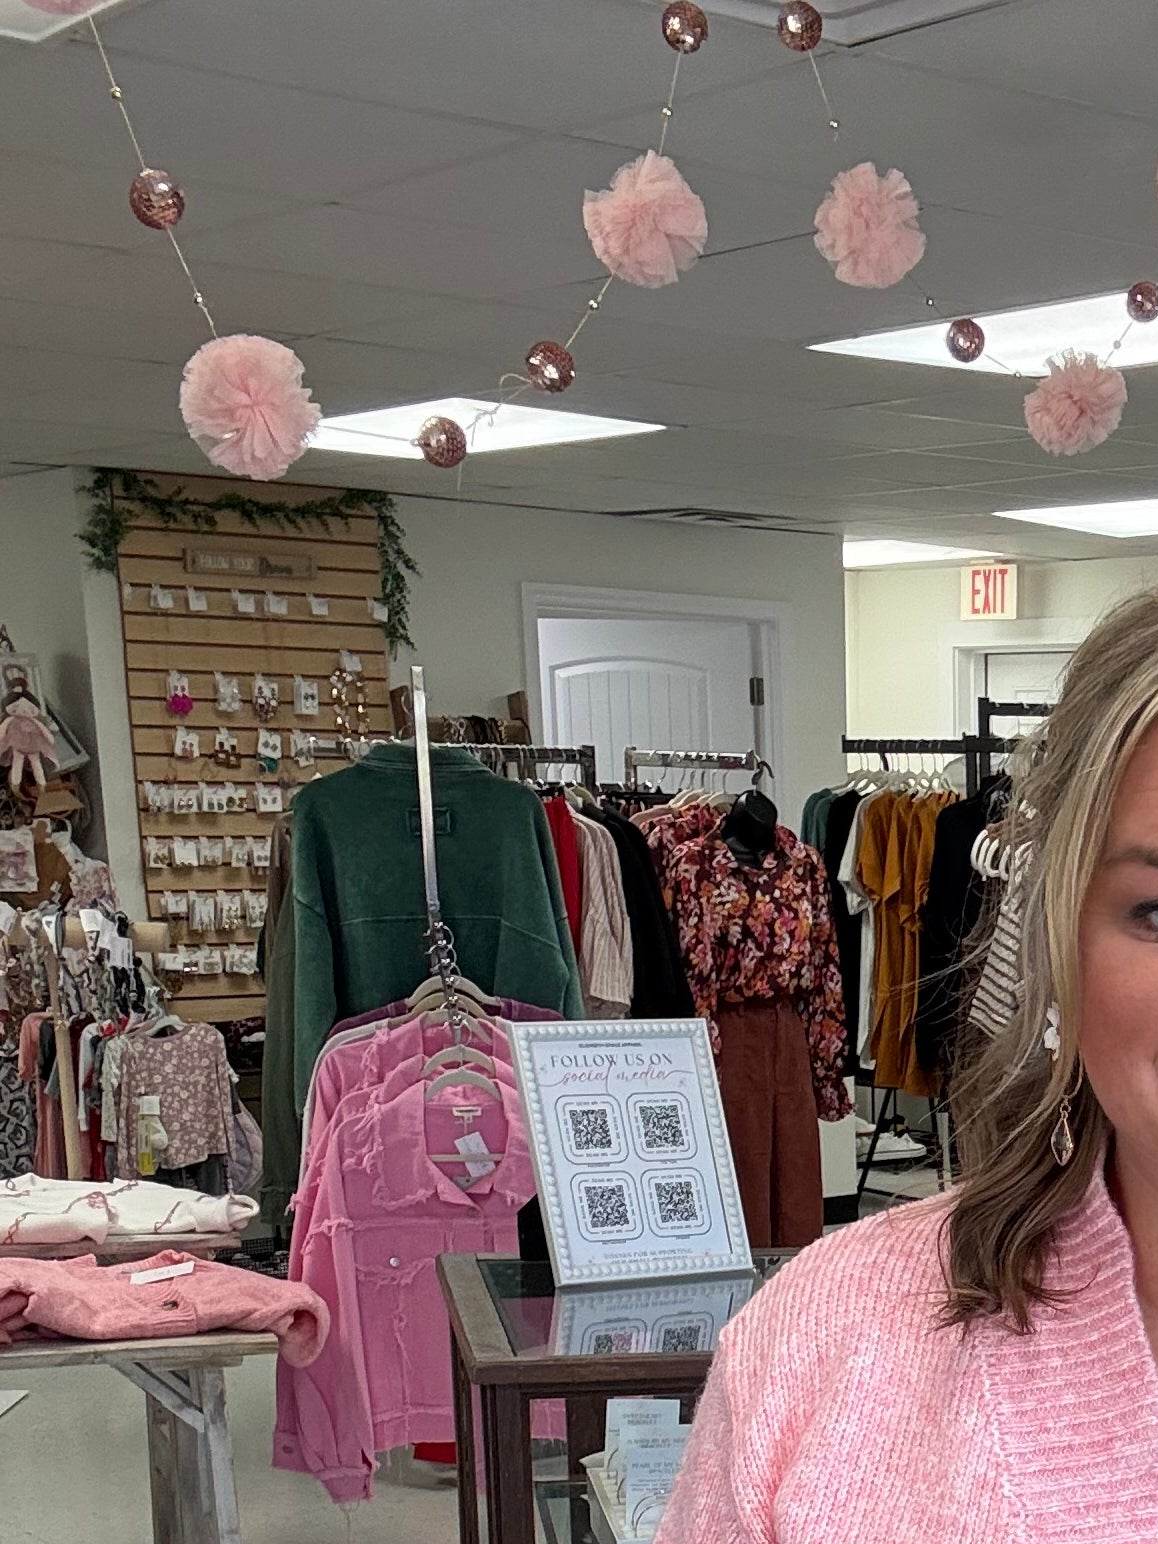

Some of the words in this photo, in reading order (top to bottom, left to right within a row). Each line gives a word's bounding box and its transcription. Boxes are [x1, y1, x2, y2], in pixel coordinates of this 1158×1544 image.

[971, 569, 1008, 614] EXIT
[551, 1054, 617, 1068] FOLLOW
[625, 1054, 645, 1066] US
[649, 1053, 673, 1066] ON
